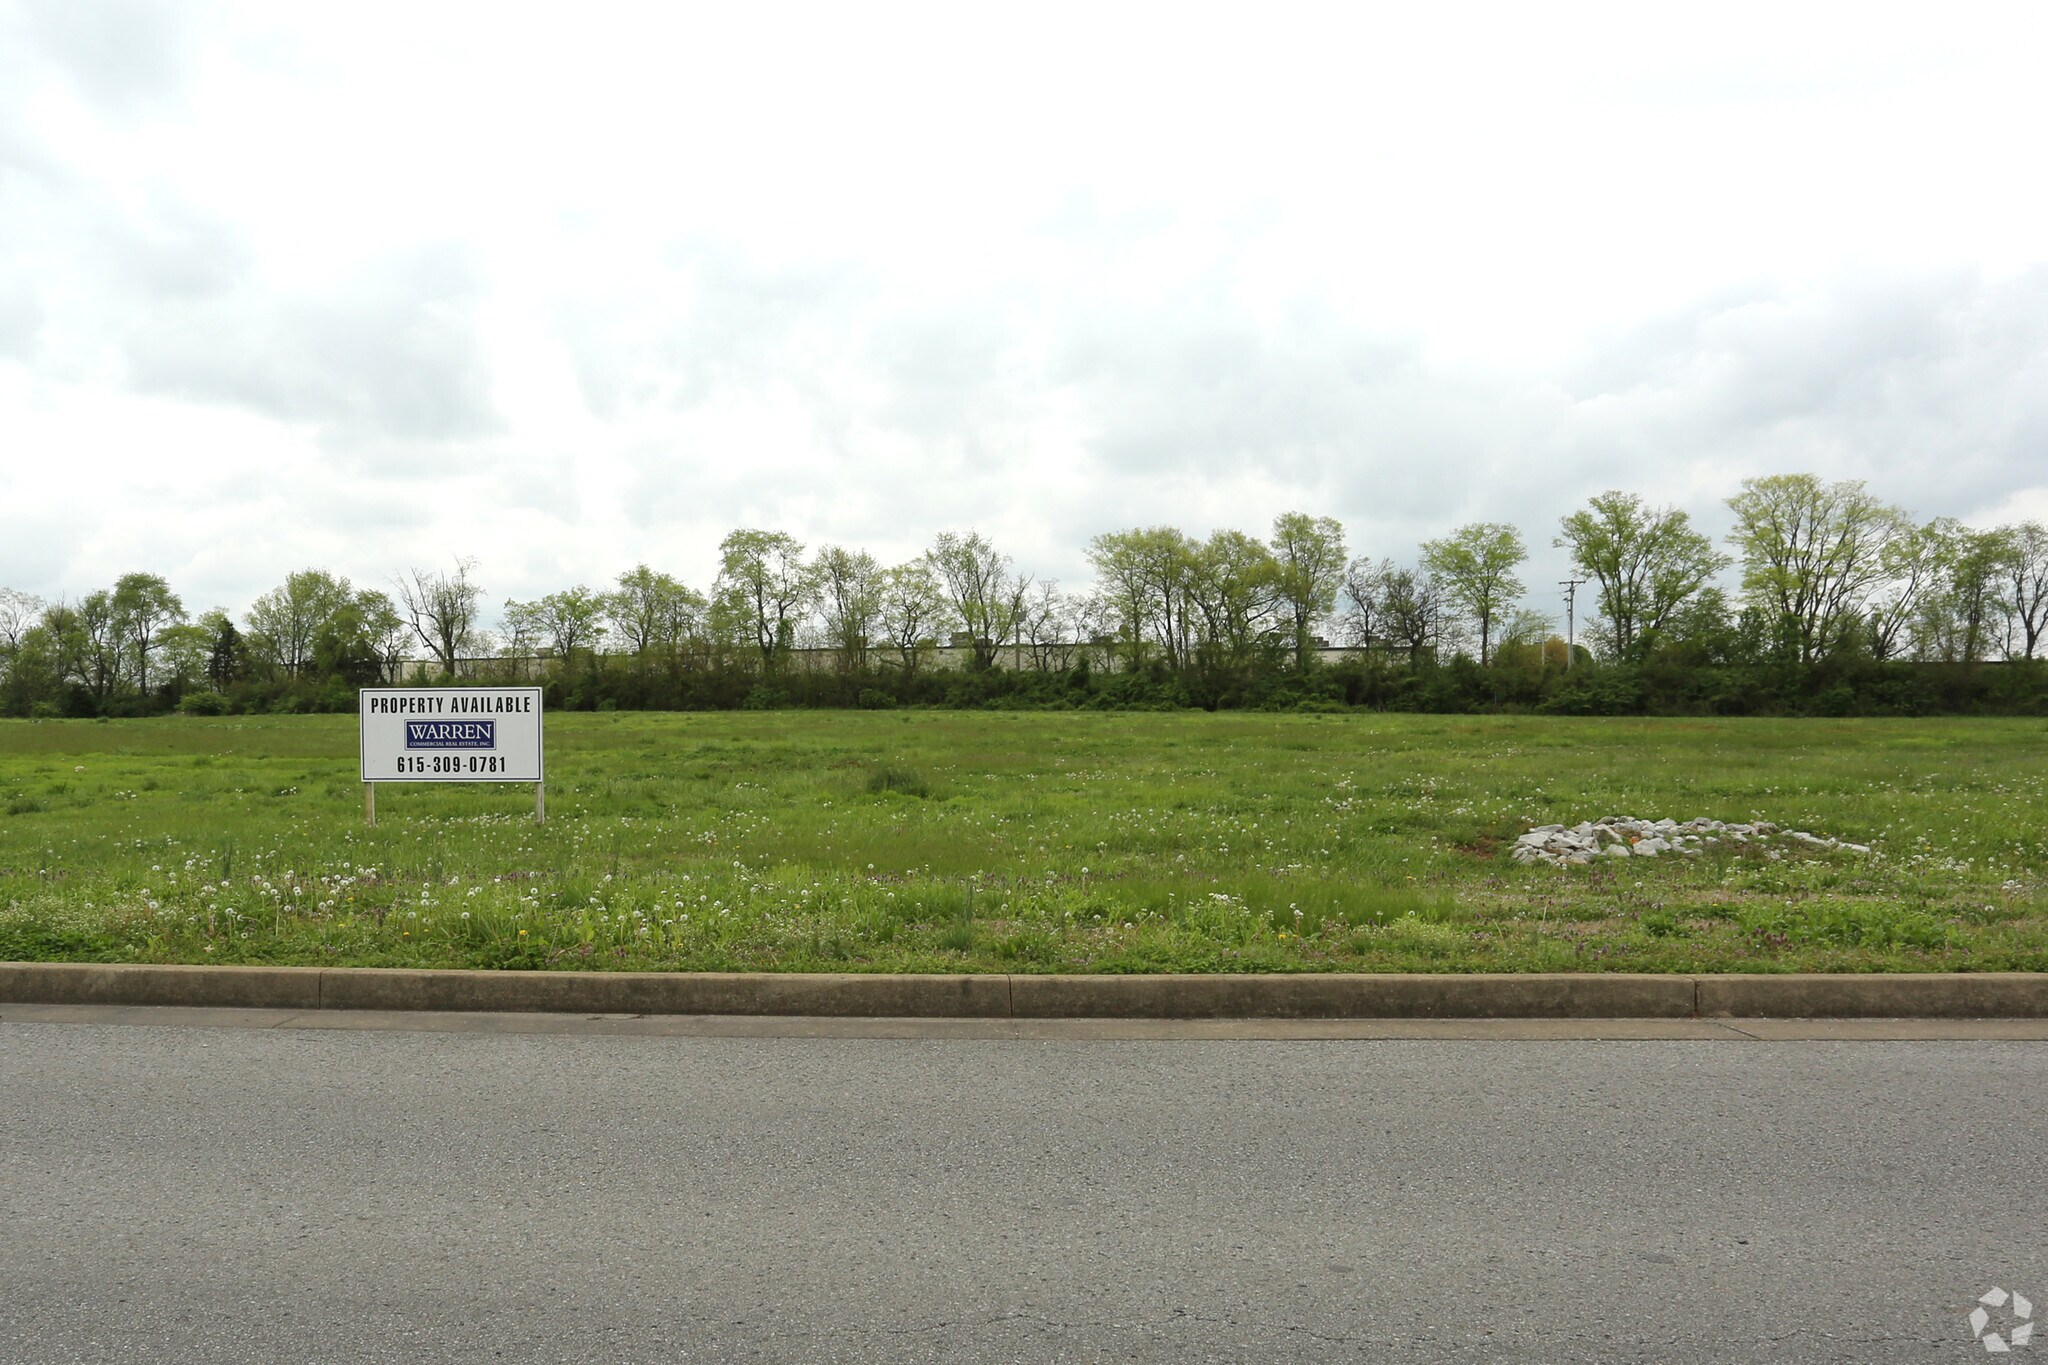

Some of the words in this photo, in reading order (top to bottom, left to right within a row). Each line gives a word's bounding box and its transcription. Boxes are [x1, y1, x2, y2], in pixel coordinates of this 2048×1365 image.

[371, 697, 444, 713] PROPERTY
[450, 696, 531, 713] AVAILABLE
[409, 724, 492, 739] WARREN
[397, 756, 506, 773] 615-309-0781
